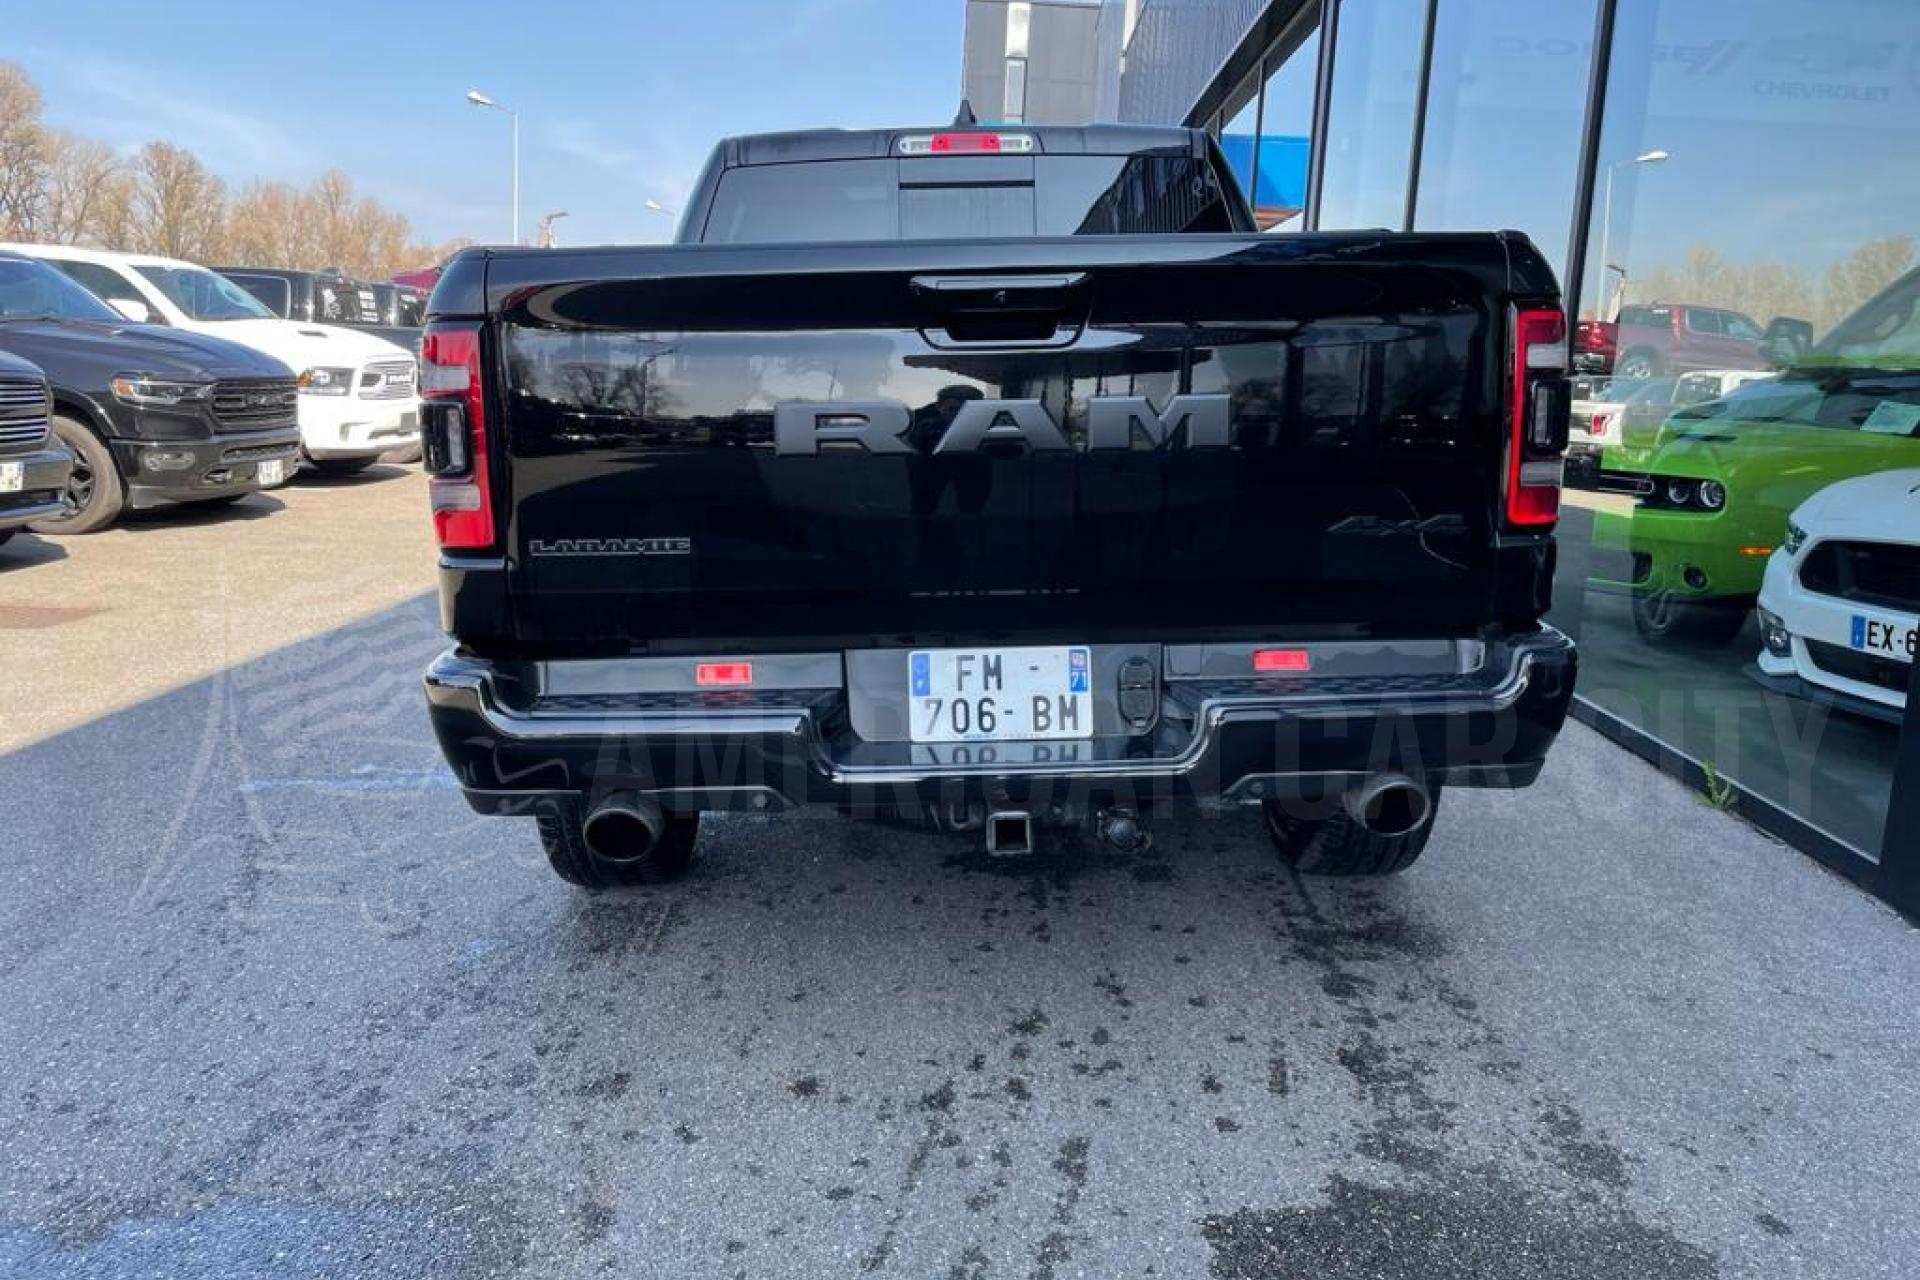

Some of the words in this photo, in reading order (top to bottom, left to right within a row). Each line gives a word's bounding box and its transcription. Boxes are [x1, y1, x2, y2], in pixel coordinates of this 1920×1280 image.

[1752, 79, 1891, 101] CHEVROLET
[774, 394, 1232, 456] RAM
[529, 536, 691, 557] LARAMIE
